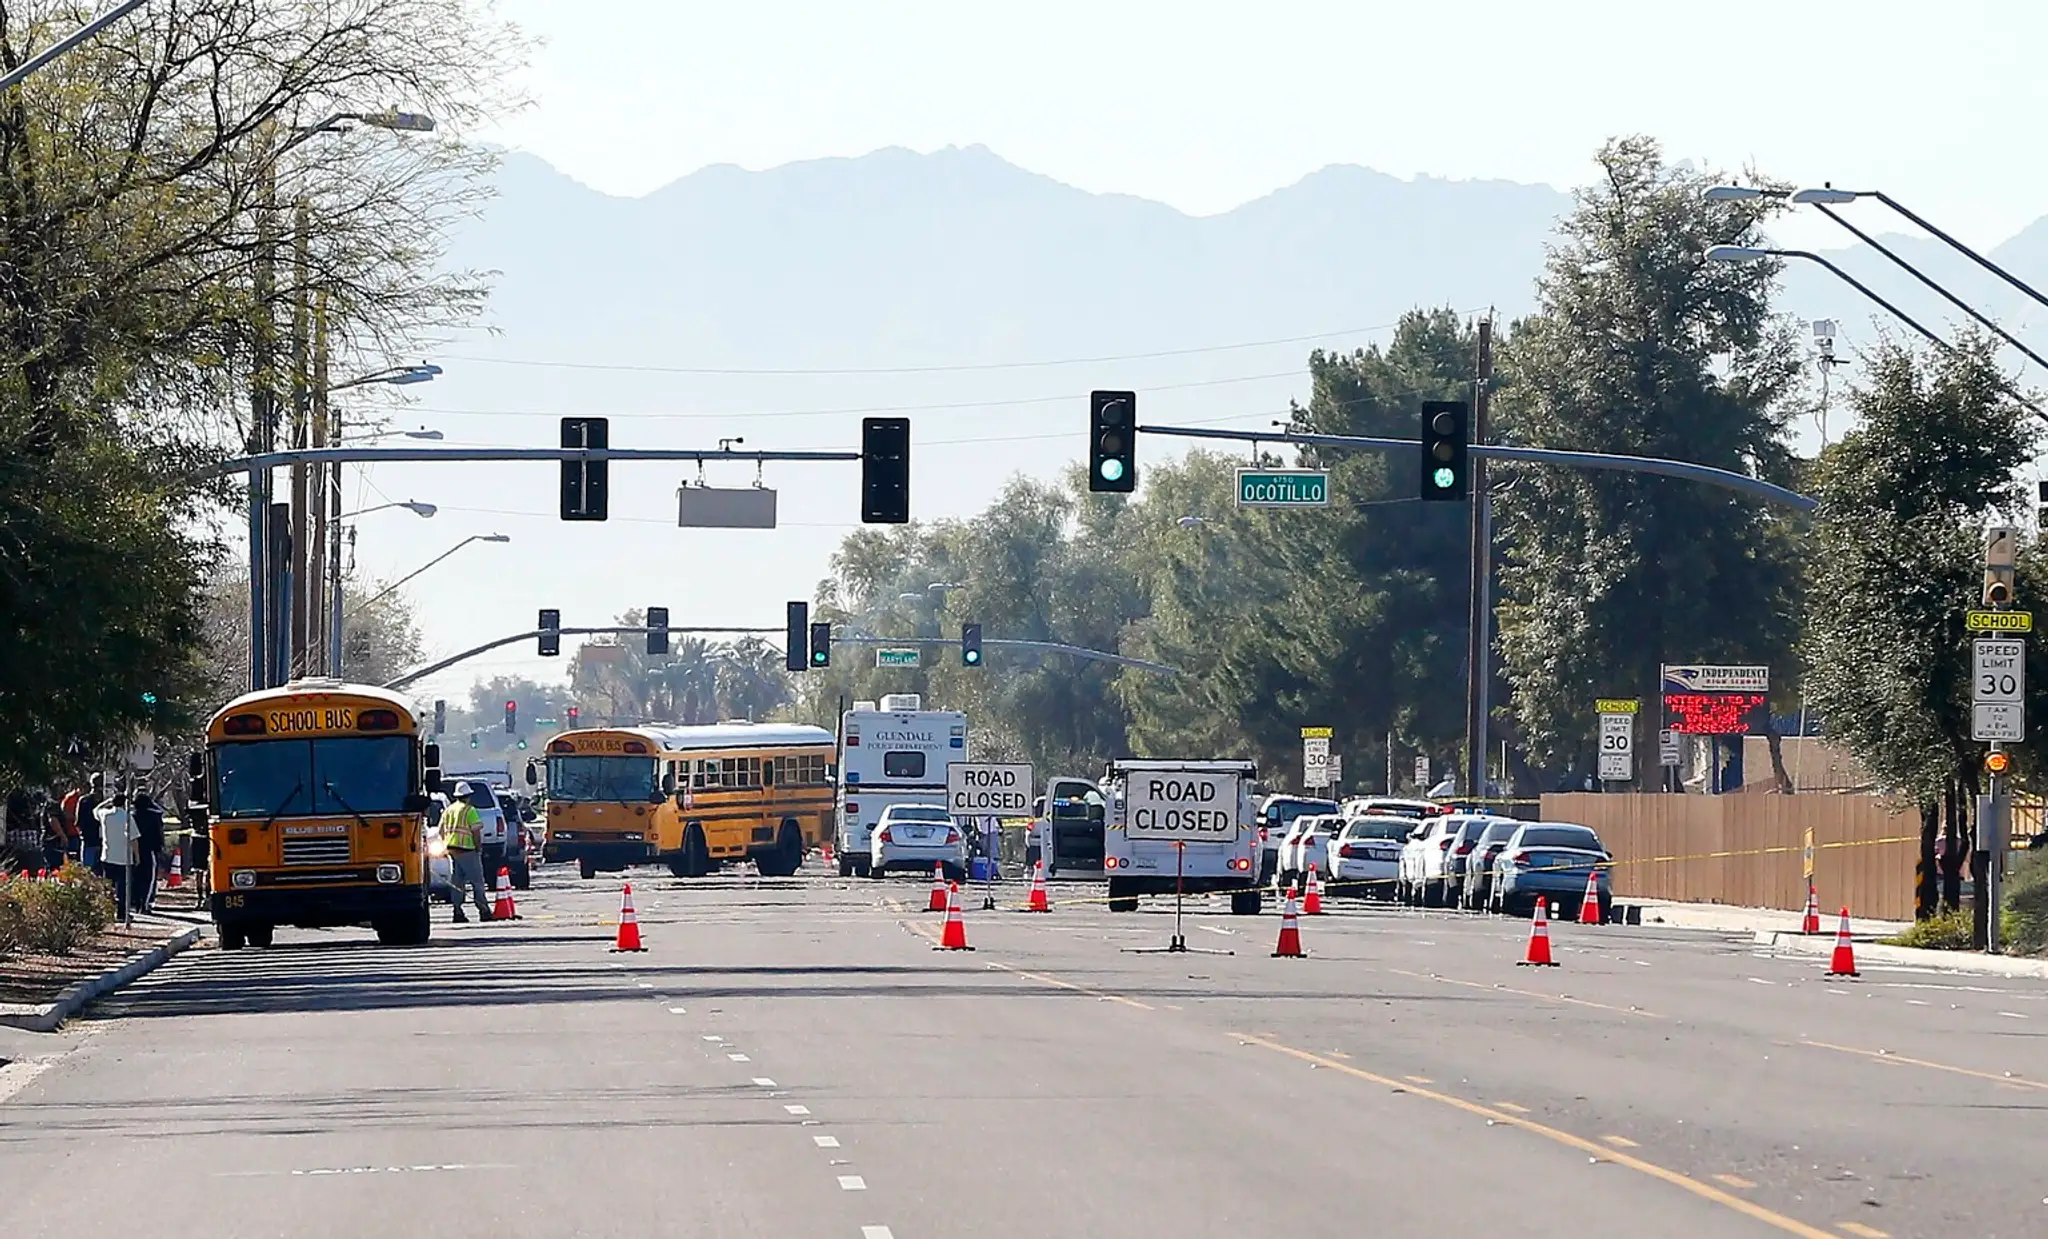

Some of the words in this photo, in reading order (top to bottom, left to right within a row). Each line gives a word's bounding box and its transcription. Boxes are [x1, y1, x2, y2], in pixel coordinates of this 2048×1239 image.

[1244, 484, 1321, 500] OCOTILLO
[1972, 615, 2027, 627] SCHOOL
[1978, 645, 2020, 656] SPEED
[1982, 658, 2014, 668] LIMIT
[1702, 668, 1767, 678] INDEPENDENCE
[1980, 674, 2016, 695] 30
[1600, 703, 1635, 712] SCHOOL
[270, 711, 322, 732] SCHOOL
[325, 709, 352, 729] BUS
[1604, 717, 1630, 725] SPEED
[876, 731, 935, 741] GLENDALE
[578, 739, 605, 751] SCHOOL
[606, 739, 622, 751] BUS
[894, 743, 944, 751] DEPARTMENT
[1604, 735, 1628, 750] 30
[1308, 754, 1327, 766] 30
[964, 770, 1016, 787] ROAD
[1149, 780, 1216, 802] ROAD
[954, 792, 1027, 809] CLOSED
[1135, 809, 1229, 832] CLOSED
[225, 895, 245, 908] 845
